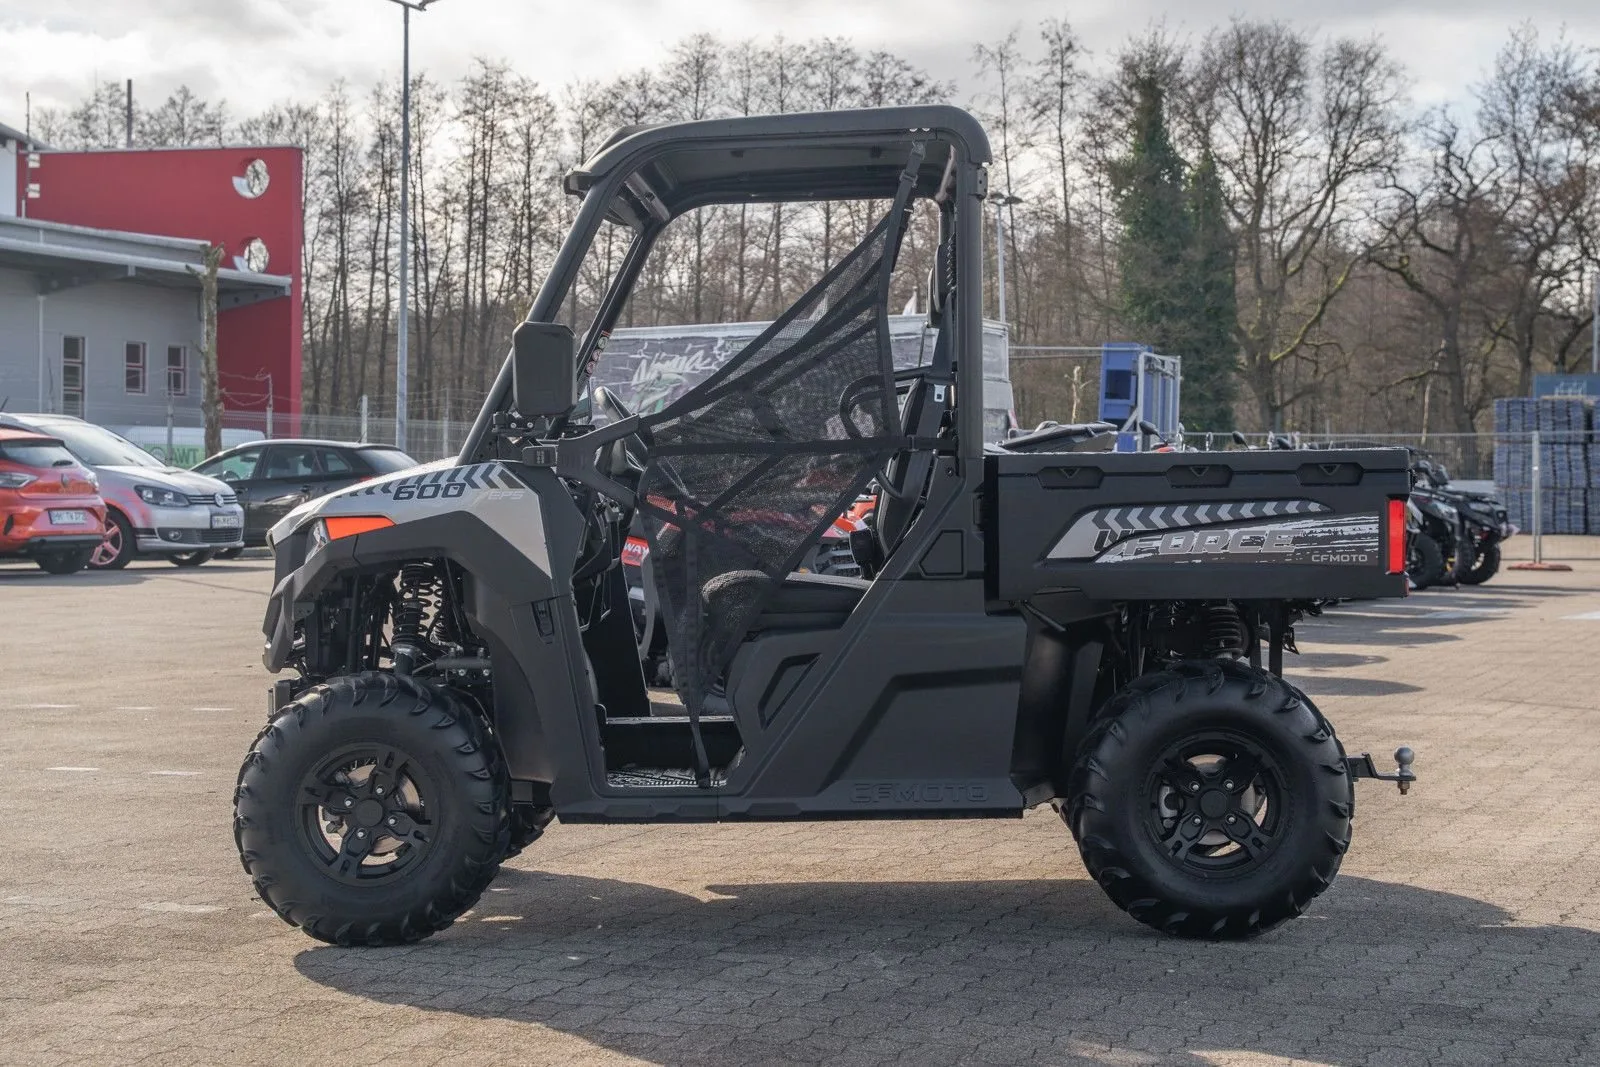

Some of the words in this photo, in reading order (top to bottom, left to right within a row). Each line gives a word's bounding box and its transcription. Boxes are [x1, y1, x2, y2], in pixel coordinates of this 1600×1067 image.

[393, 482, 466, 500] 600
[487, 490, 525, 500] EPS
[1093, 528, 1302, 554] UFORCE
[1311, 554, 1368, 562] CFMOTO
[850, 782, 989, 803] CFMOTO
